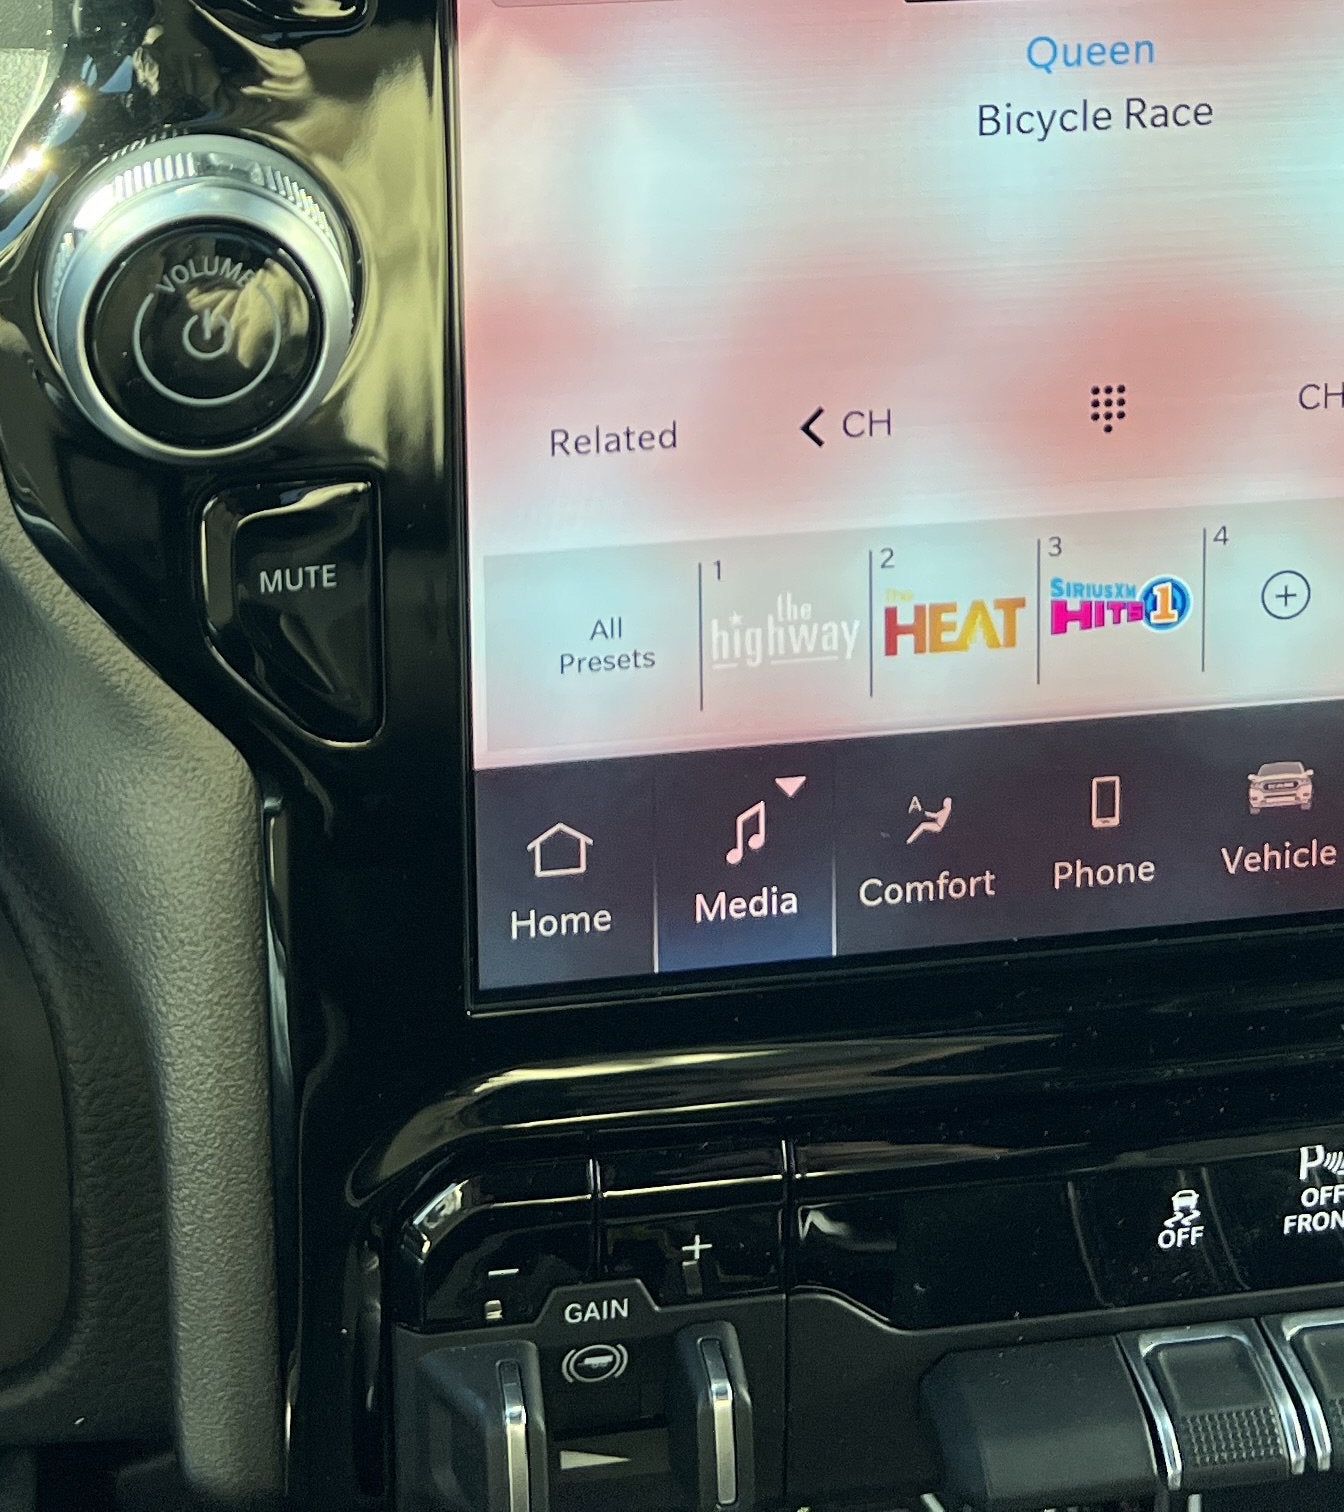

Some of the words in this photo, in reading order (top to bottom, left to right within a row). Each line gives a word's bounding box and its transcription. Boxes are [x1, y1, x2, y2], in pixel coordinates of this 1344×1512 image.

[1026, 35, 1155, 74] Queen
[977, 99, 1112, 142] Bicycle
[1125, 97, 1214, 130] Race
[155, 254, 256, 295] VOLUME
[550, 420, 678, 457] Related
[842, 408, 893, 438] CH
[1048, 536, 1063, 557] 3
[1212, 525, 1230, 546] 4
[713, 559, 723, 581] 1
[879, 547, 896, 569] 2
[259, 563, 337, 595] MUTE
[776, 592, 812, 622] the
[1050, 598, 1144, 635] HITS
[1150, 580, 1179, 626] 1
[590, 616, 622, 641] All
[712, 615, 858, 667] highway
[884, 597, 1026, 656] HEAT
[559, 647, 656, 675] Presets
[1053, 856, 1156, 889] Phone
[1220, 839, 1338, 875] Vehicle
[859, 869, 996, 907] Comfort
[694, 887, 798, 924] Media
[510, 906, 612, 940] Home
[1157, 1225, 1204, 1249] OFF
[564, 1298, 629, 1323] GAIN
